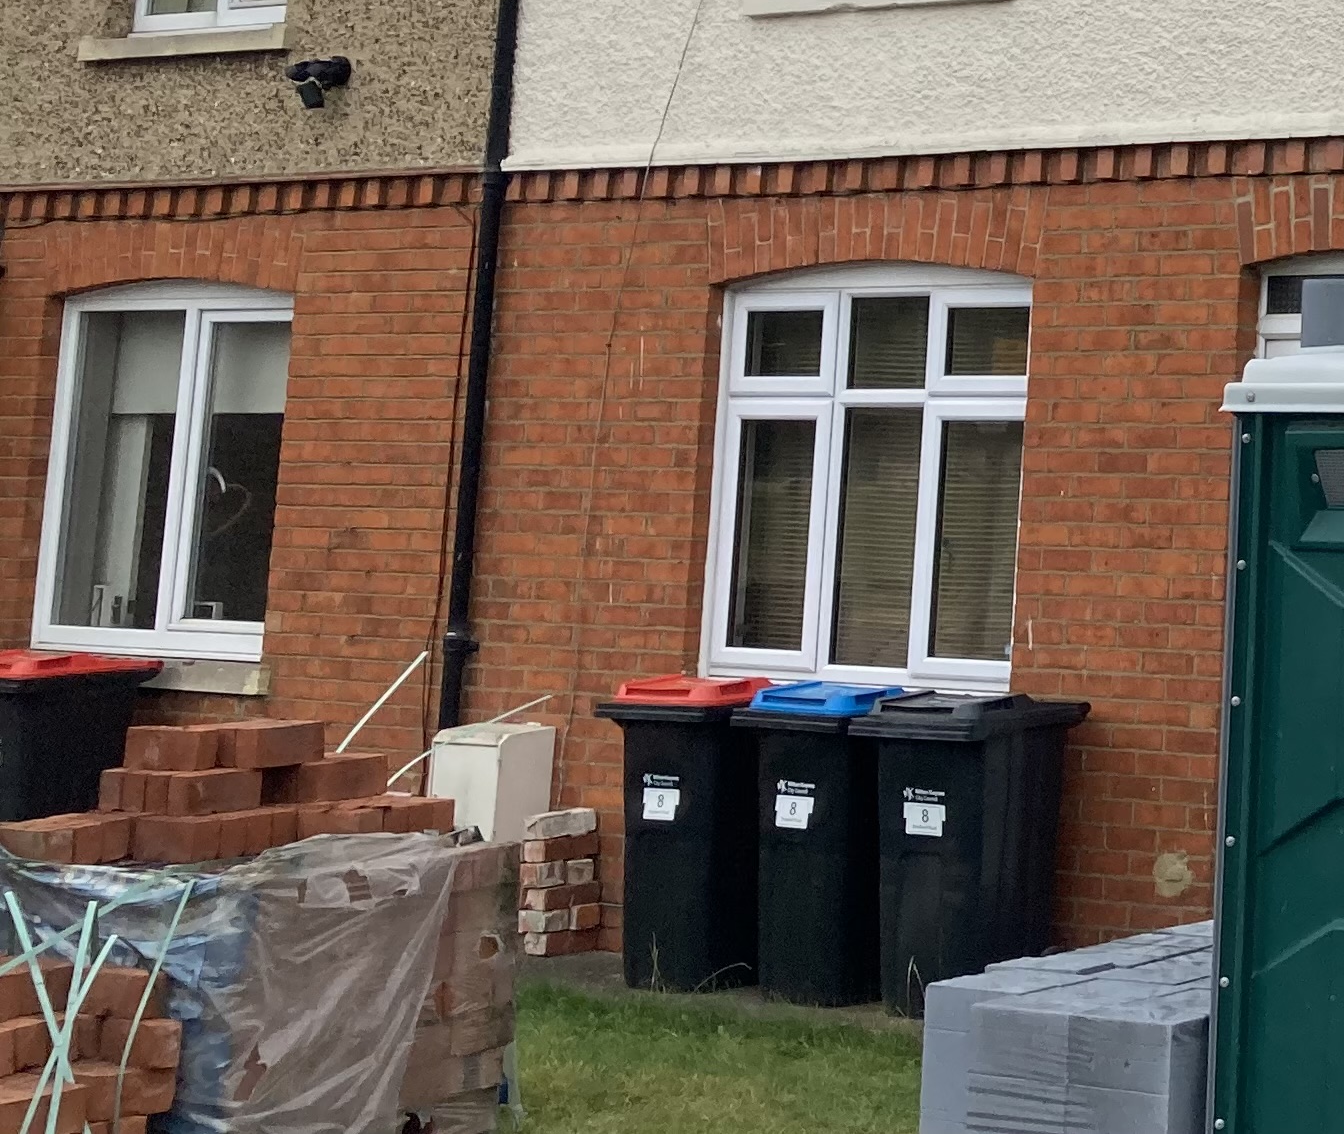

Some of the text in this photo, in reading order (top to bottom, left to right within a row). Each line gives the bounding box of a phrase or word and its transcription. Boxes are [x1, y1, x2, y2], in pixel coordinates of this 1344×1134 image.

[657, 794, 664, 808] 8
[790, 801, 797, 816] 8
[921, 808, 930, 823] 8
